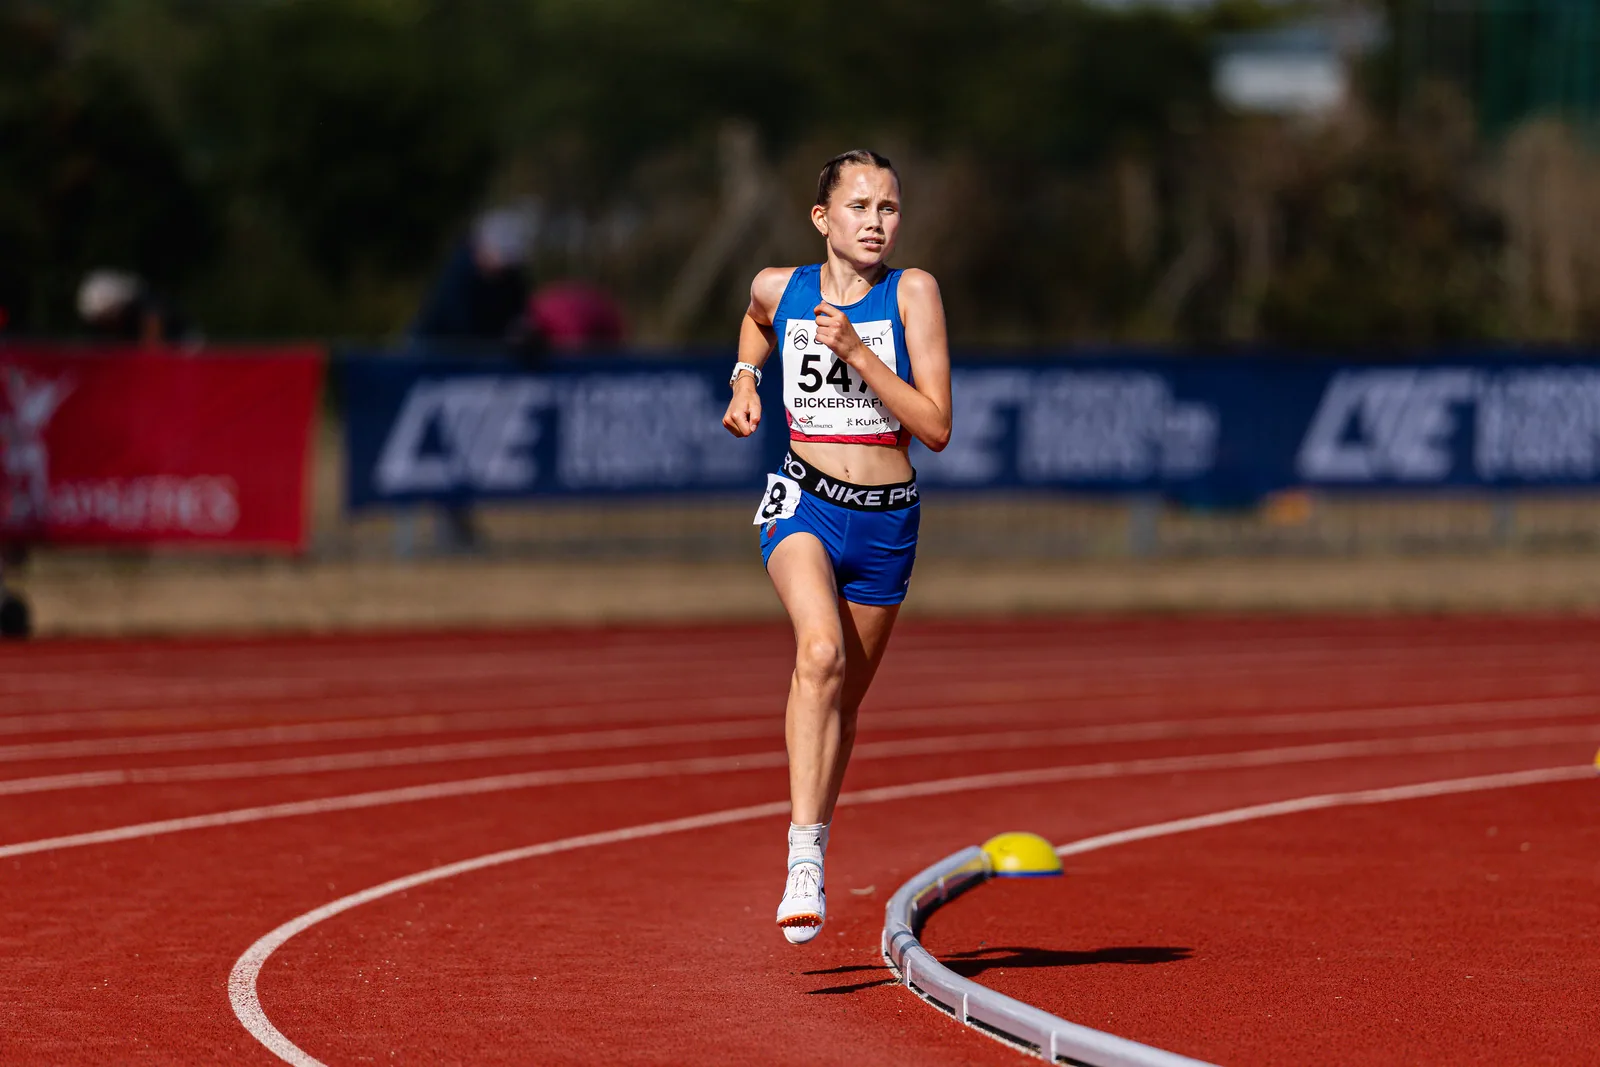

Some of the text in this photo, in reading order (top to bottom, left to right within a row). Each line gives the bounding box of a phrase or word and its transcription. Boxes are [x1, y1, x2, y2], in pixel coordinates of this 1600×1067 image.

[797, 354, 868, 394] 54
[855, 417, 890, 426] KUKRI
[762, 481, 787, 519] 8
[815, 478, 884, 506] NIKE
